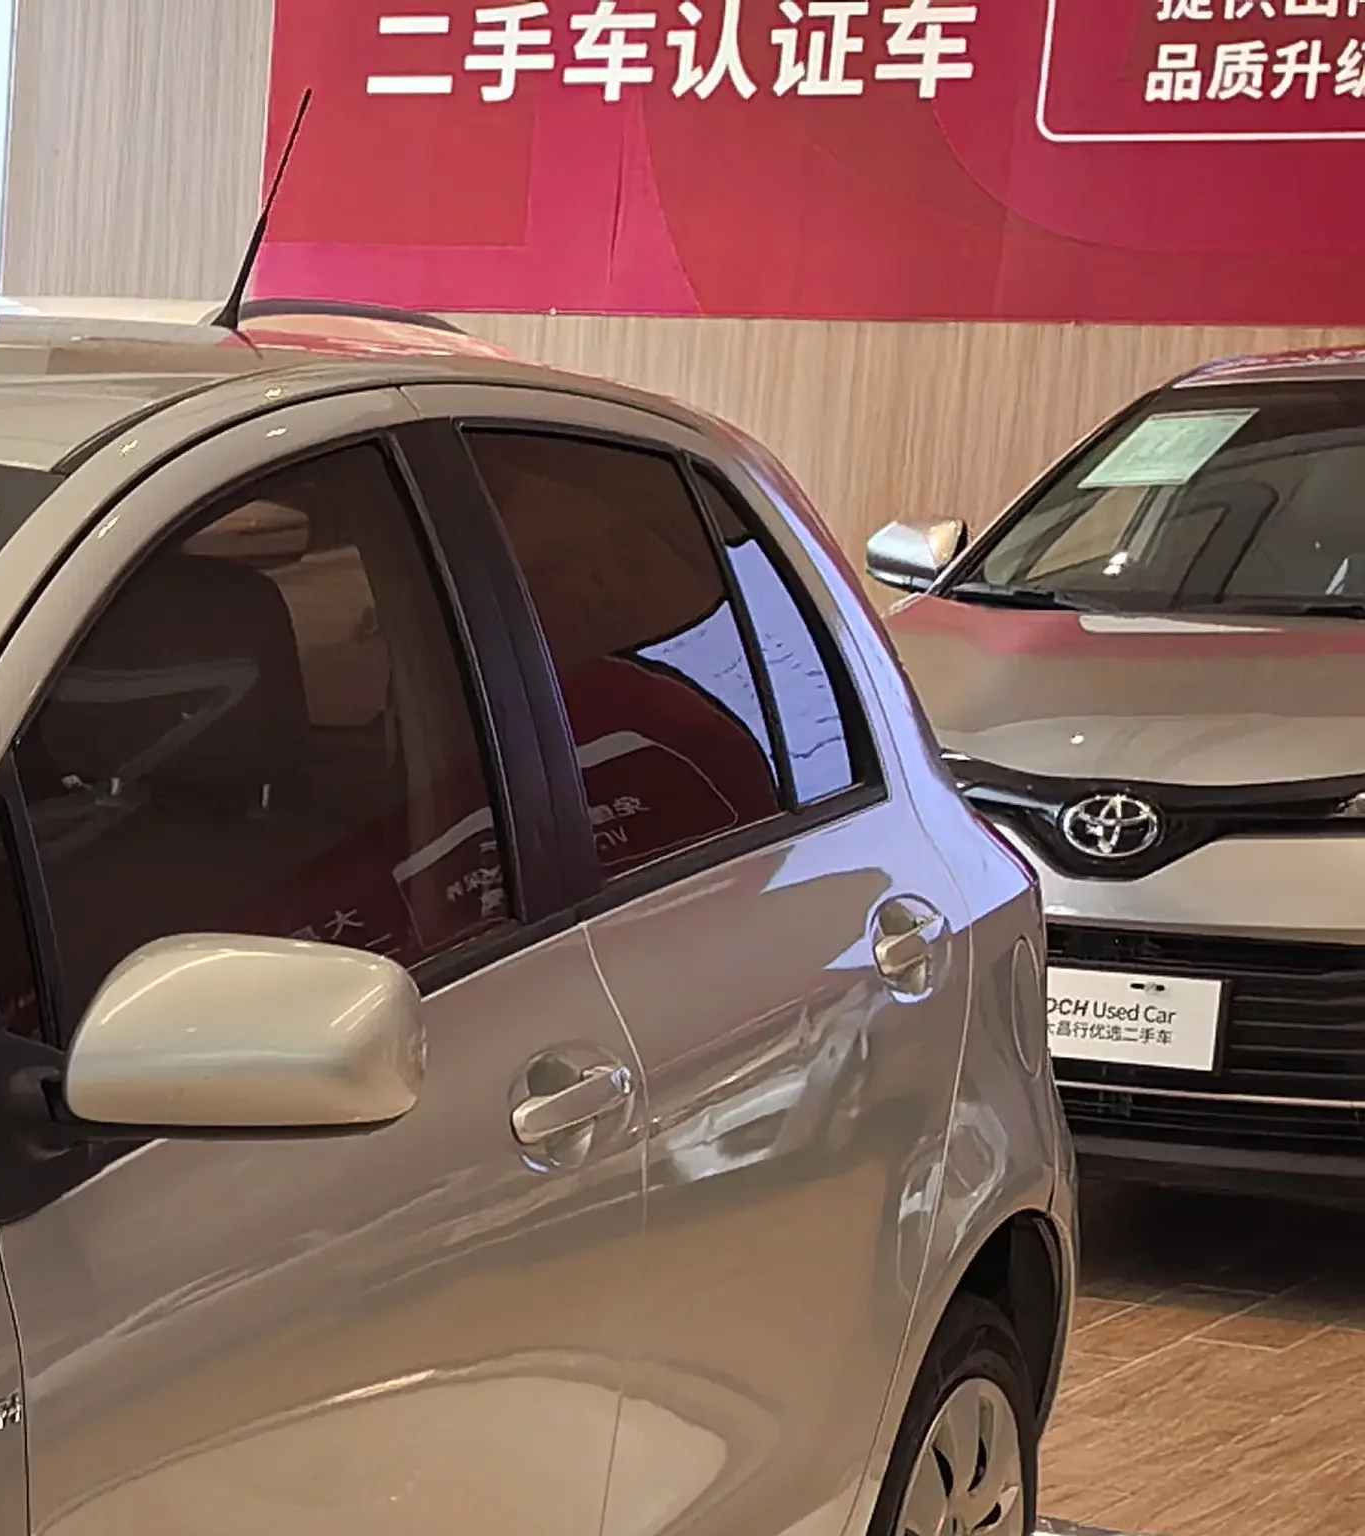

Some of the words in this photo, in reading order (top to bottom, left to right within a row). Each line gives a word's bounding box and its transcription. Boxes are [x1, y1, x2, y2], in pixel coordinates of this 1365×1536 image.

[367, 0, 977, 102] 二手车认证车
[1047, 997, 1089, 1017] DCH
[1093, 1001, 1140, 1022] Used
[1143, 1004, 1177, 1025] Car
